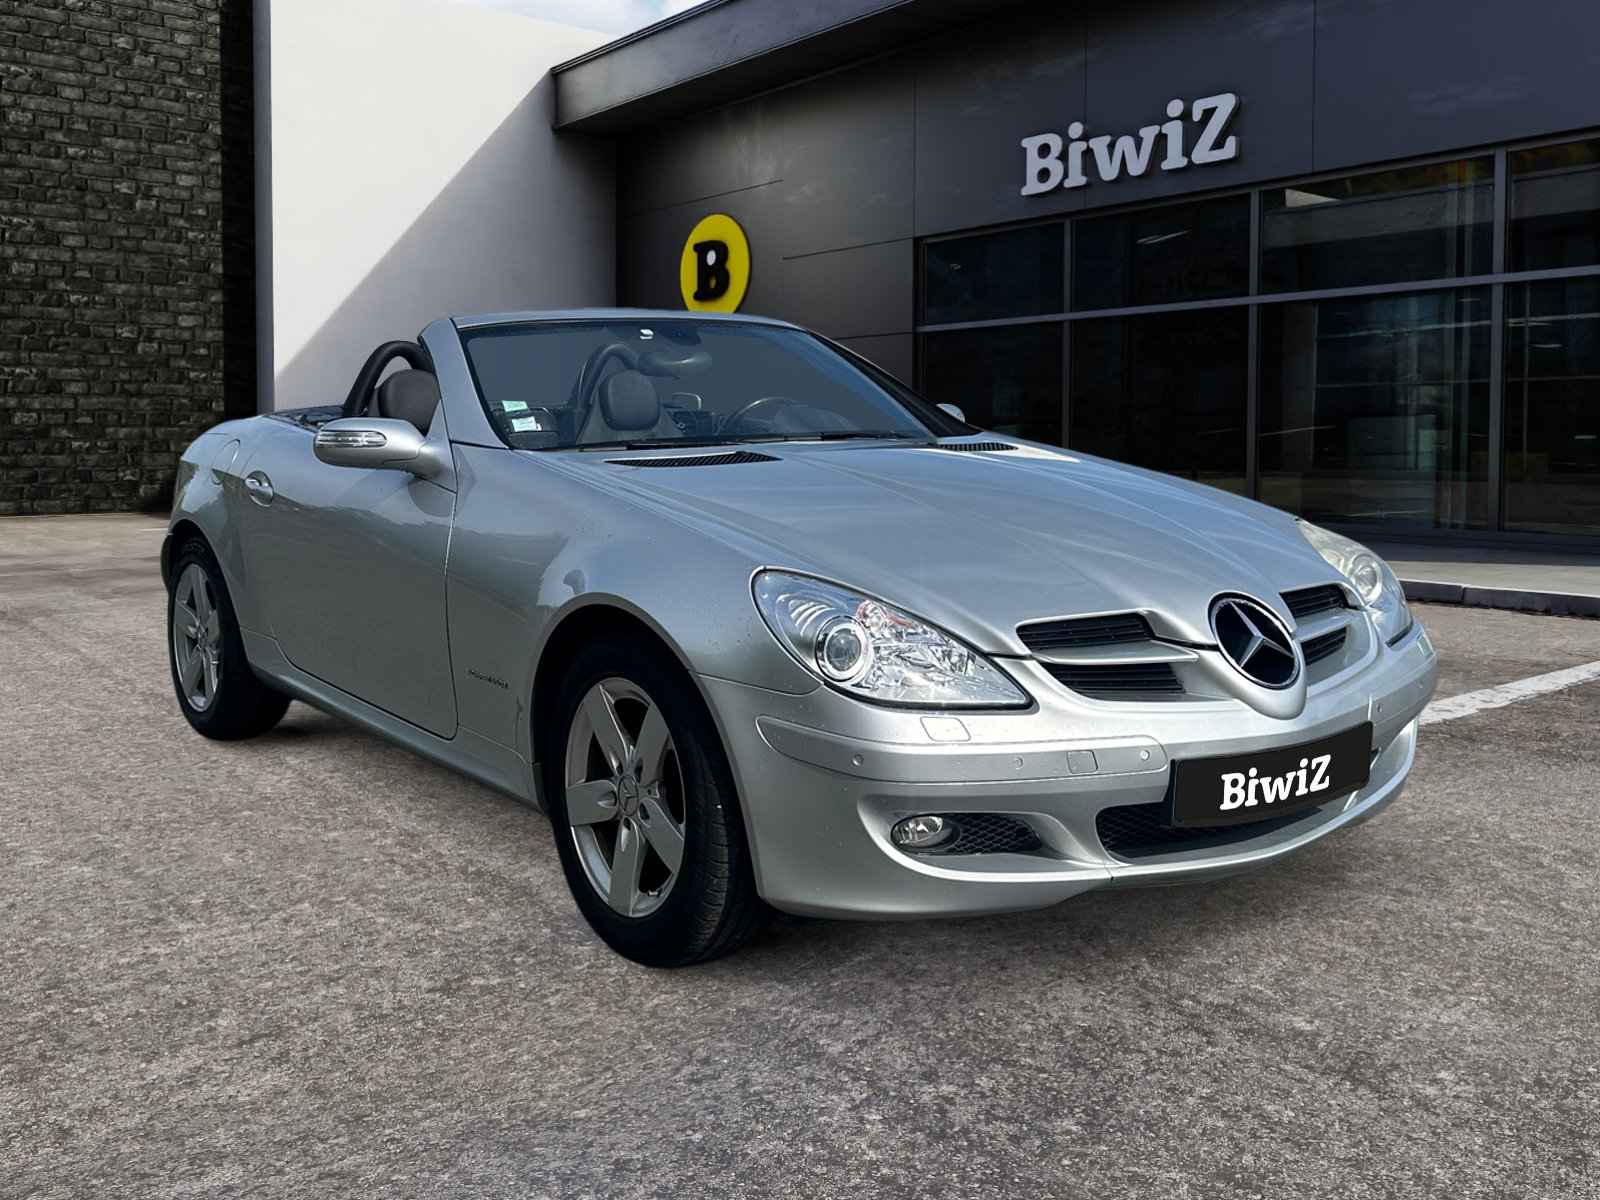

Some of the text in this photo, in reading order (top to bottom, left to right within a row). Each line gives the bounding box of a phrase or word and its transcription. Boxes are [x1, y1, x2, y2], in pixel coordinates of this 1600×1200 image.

[1020, 93, 1239, 196] BiwiZ
[693, 240, 730, 301] B
[1219, 754, 1332, 810] BiwiZ
